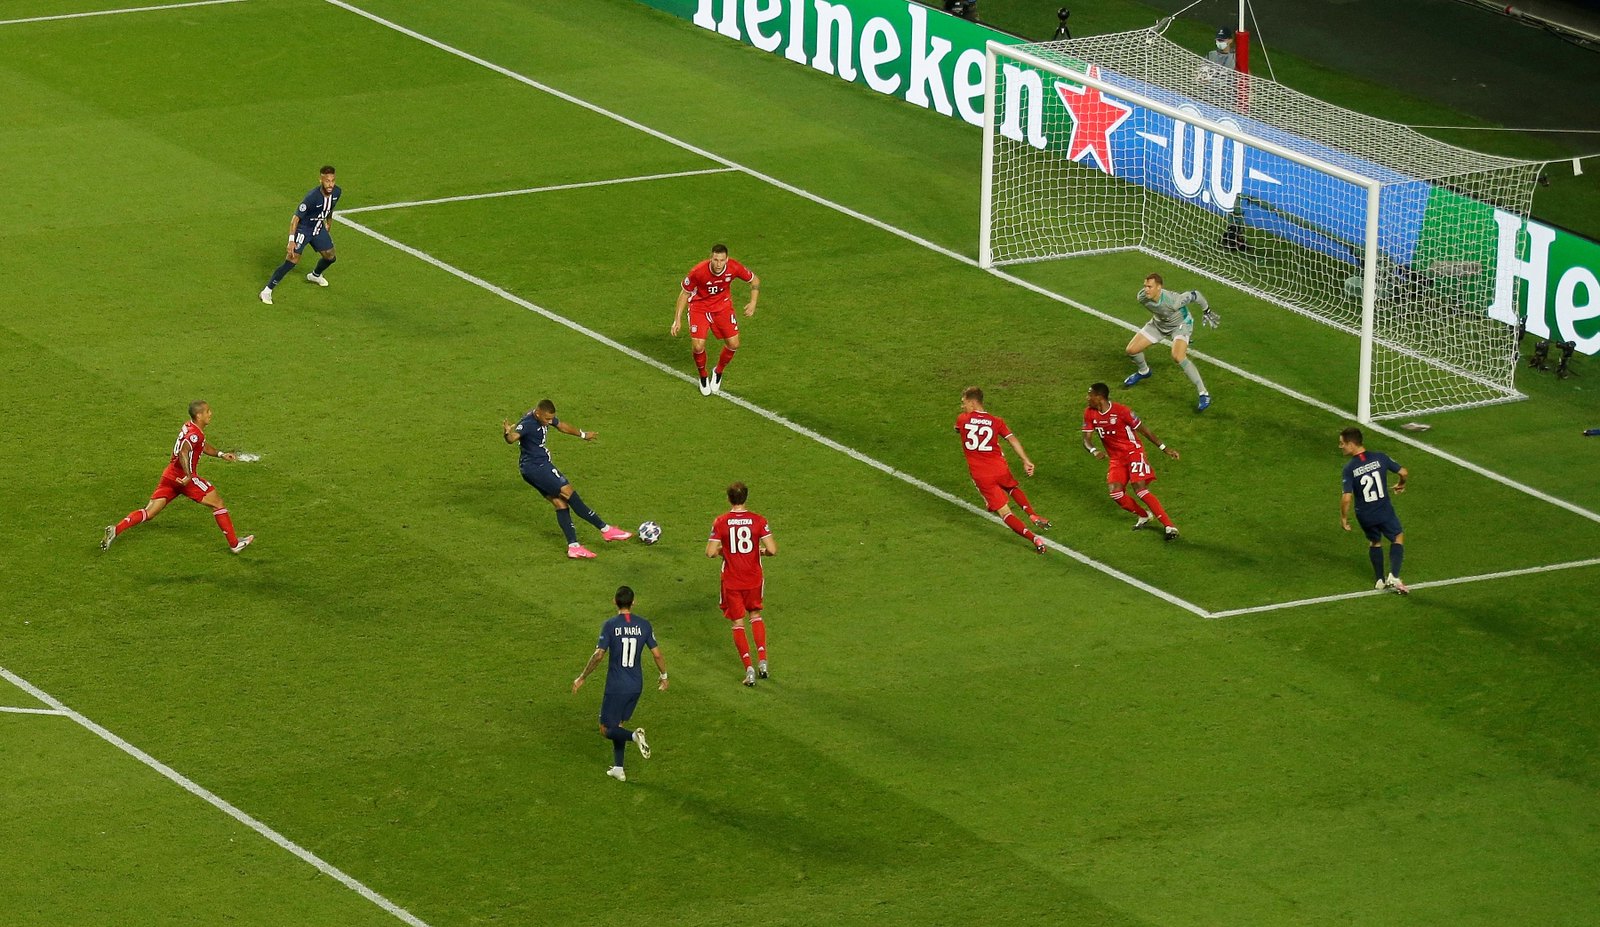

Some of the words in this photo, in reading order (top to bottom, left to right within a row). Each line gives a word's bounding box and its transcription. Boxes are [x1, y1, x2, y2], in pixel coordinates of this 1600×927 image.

[964, 424, 993, 451] 32
[1130, 461, 1144, 473] 27
[1360, 470, 1385, 503] 21
[729, 526, 753, 554] 18
[621, 637, 637, 668] 11
